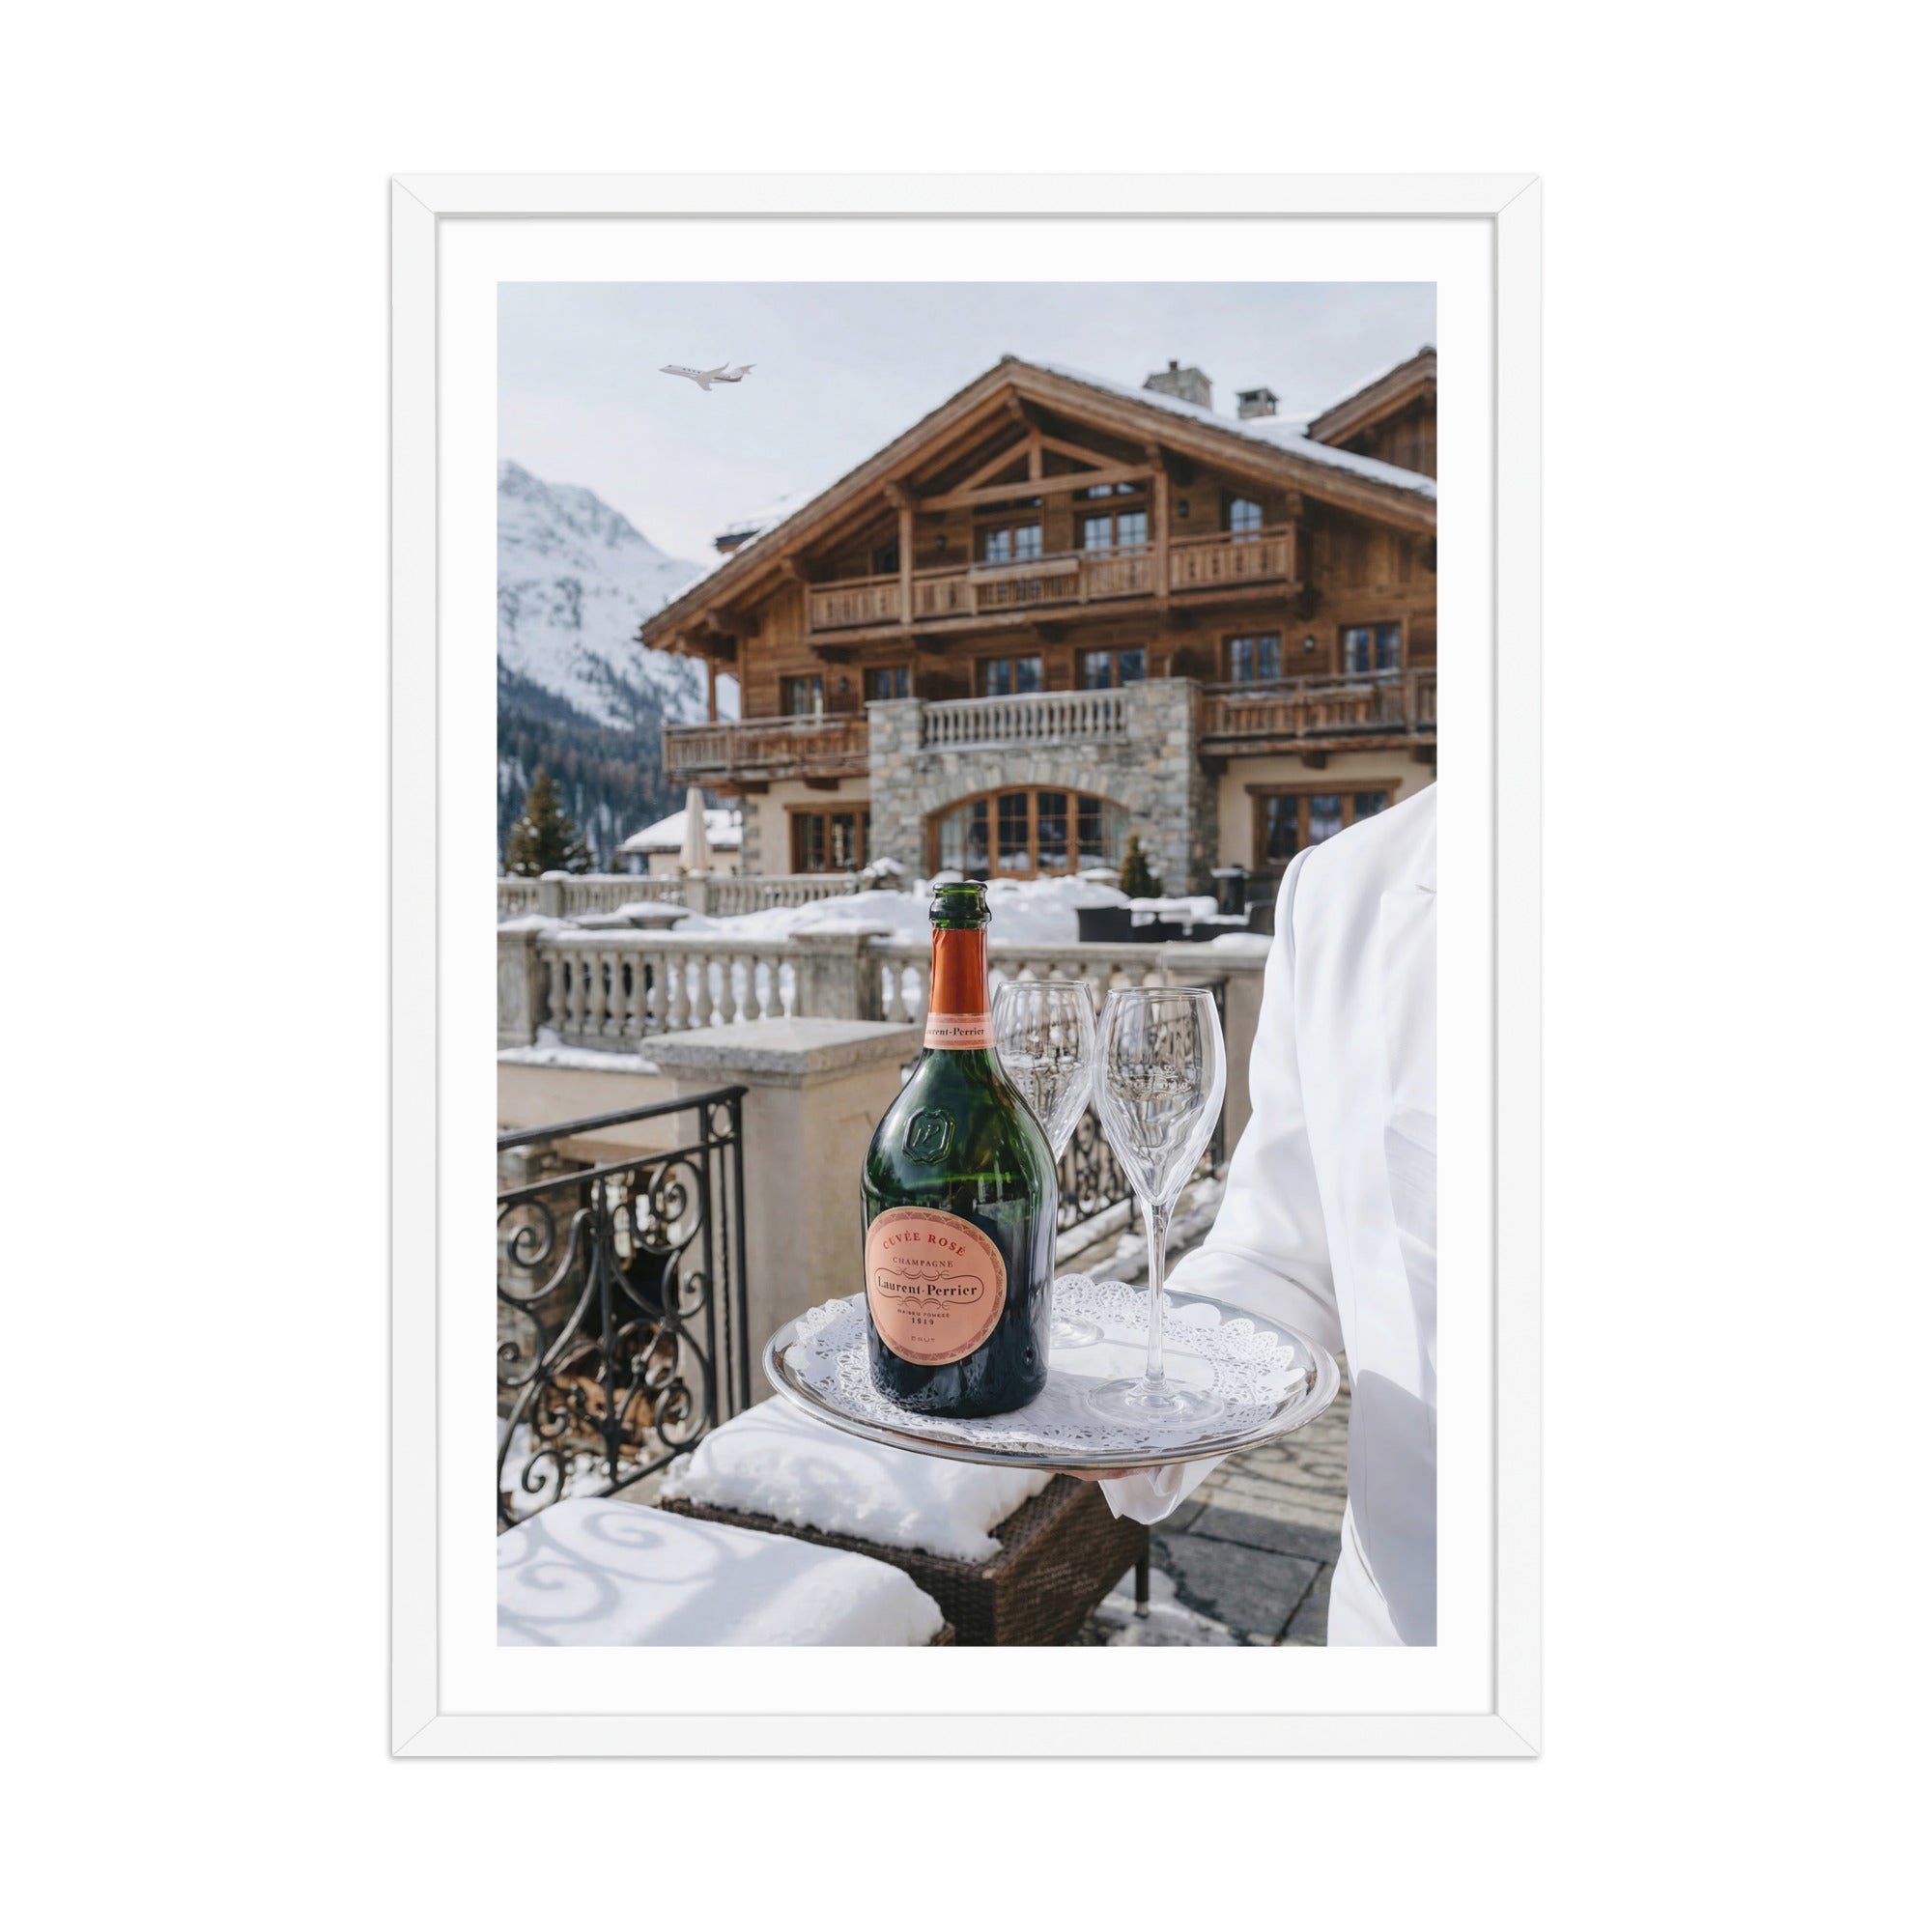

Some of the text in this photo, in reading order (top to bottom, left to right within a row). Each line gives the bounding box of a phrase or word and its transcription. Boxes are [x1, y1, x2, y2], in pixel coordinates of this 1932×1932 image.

[926, 1027, 984, 1037] urent-Perrier
[883, 1230, 966, 1256] CUVÉE ROSÉ
[893, 1257, 953, 1267] CHAMPAGNE
[878, 1275, 978, 1295] Laurent-Perrier
